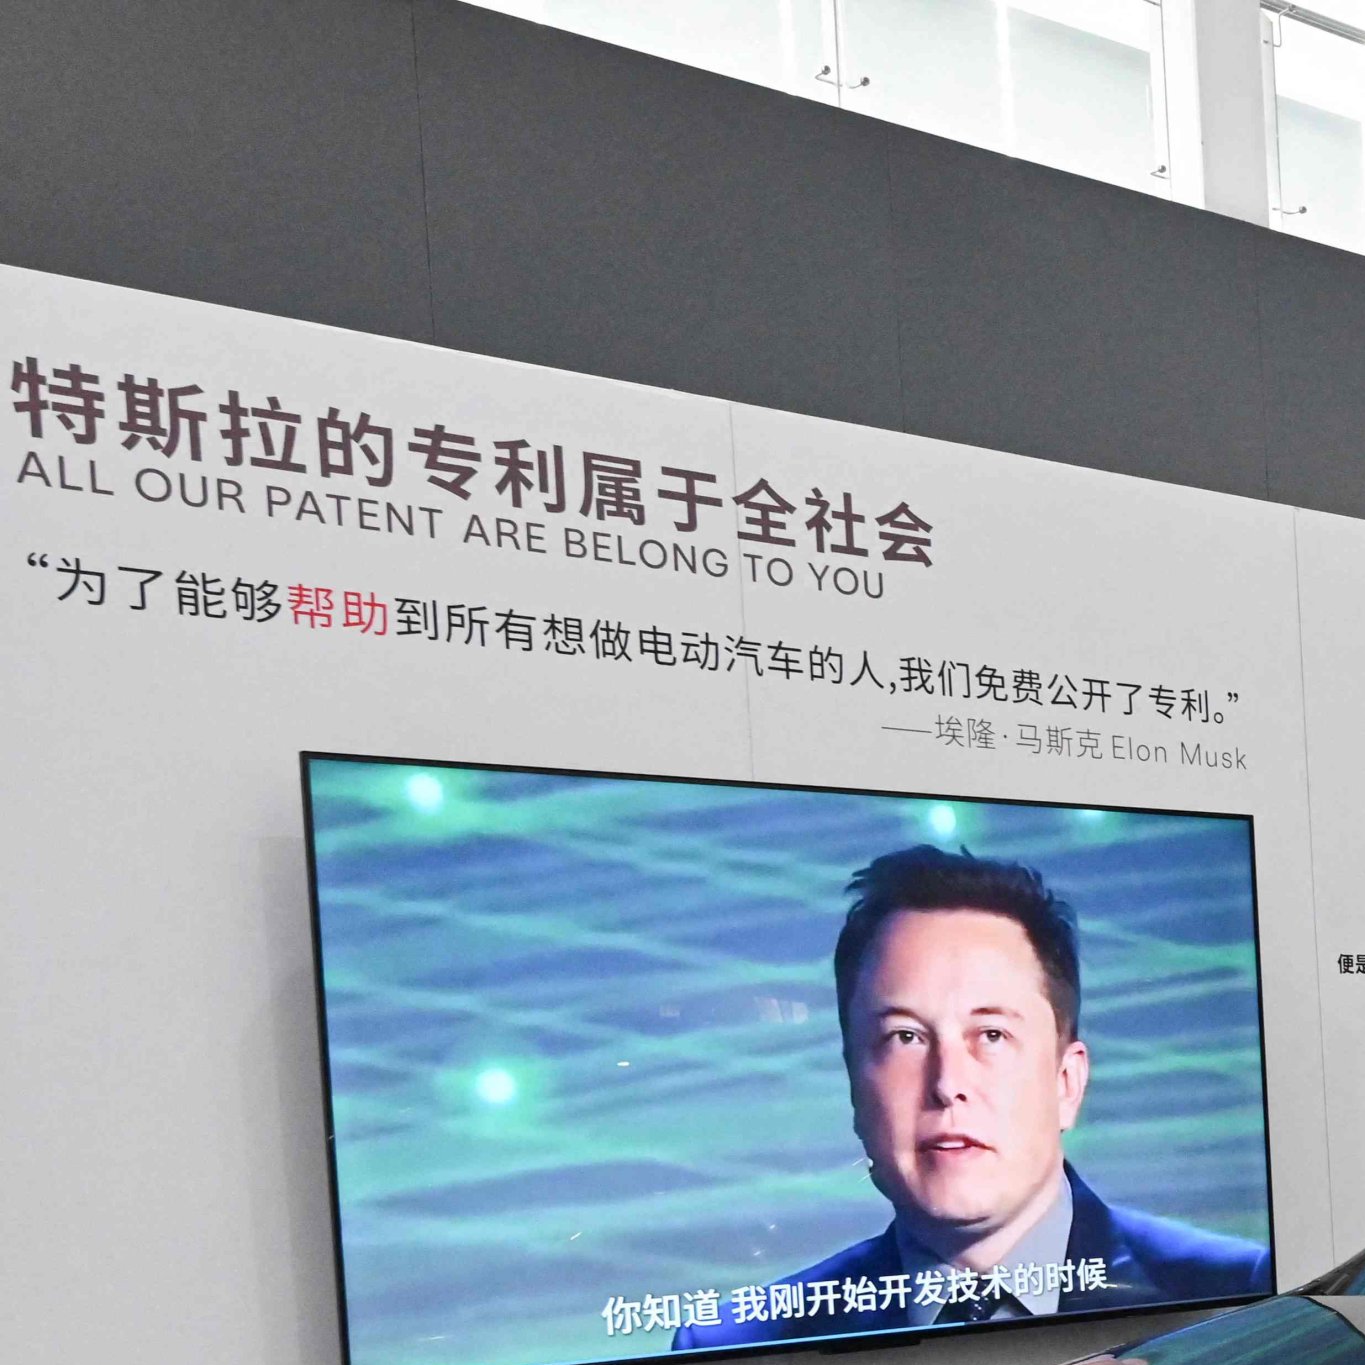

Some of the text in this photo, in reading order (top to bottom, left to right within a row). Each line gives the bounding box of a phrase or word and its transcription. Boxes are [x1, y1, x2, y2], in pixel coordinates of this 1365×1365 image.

[11, 355, 934, 568] 特斯拉的专利属于全社会
[17, 451, 884, 599] ALL OUR PATENT ARE BELONG TO YOU
[1111, 735, 1167, 763] Elon
[1180, 741, 1247, 770] Musk
[601, 1257, 1109, 1336] 你知道 我刚开始开发技术的时候
